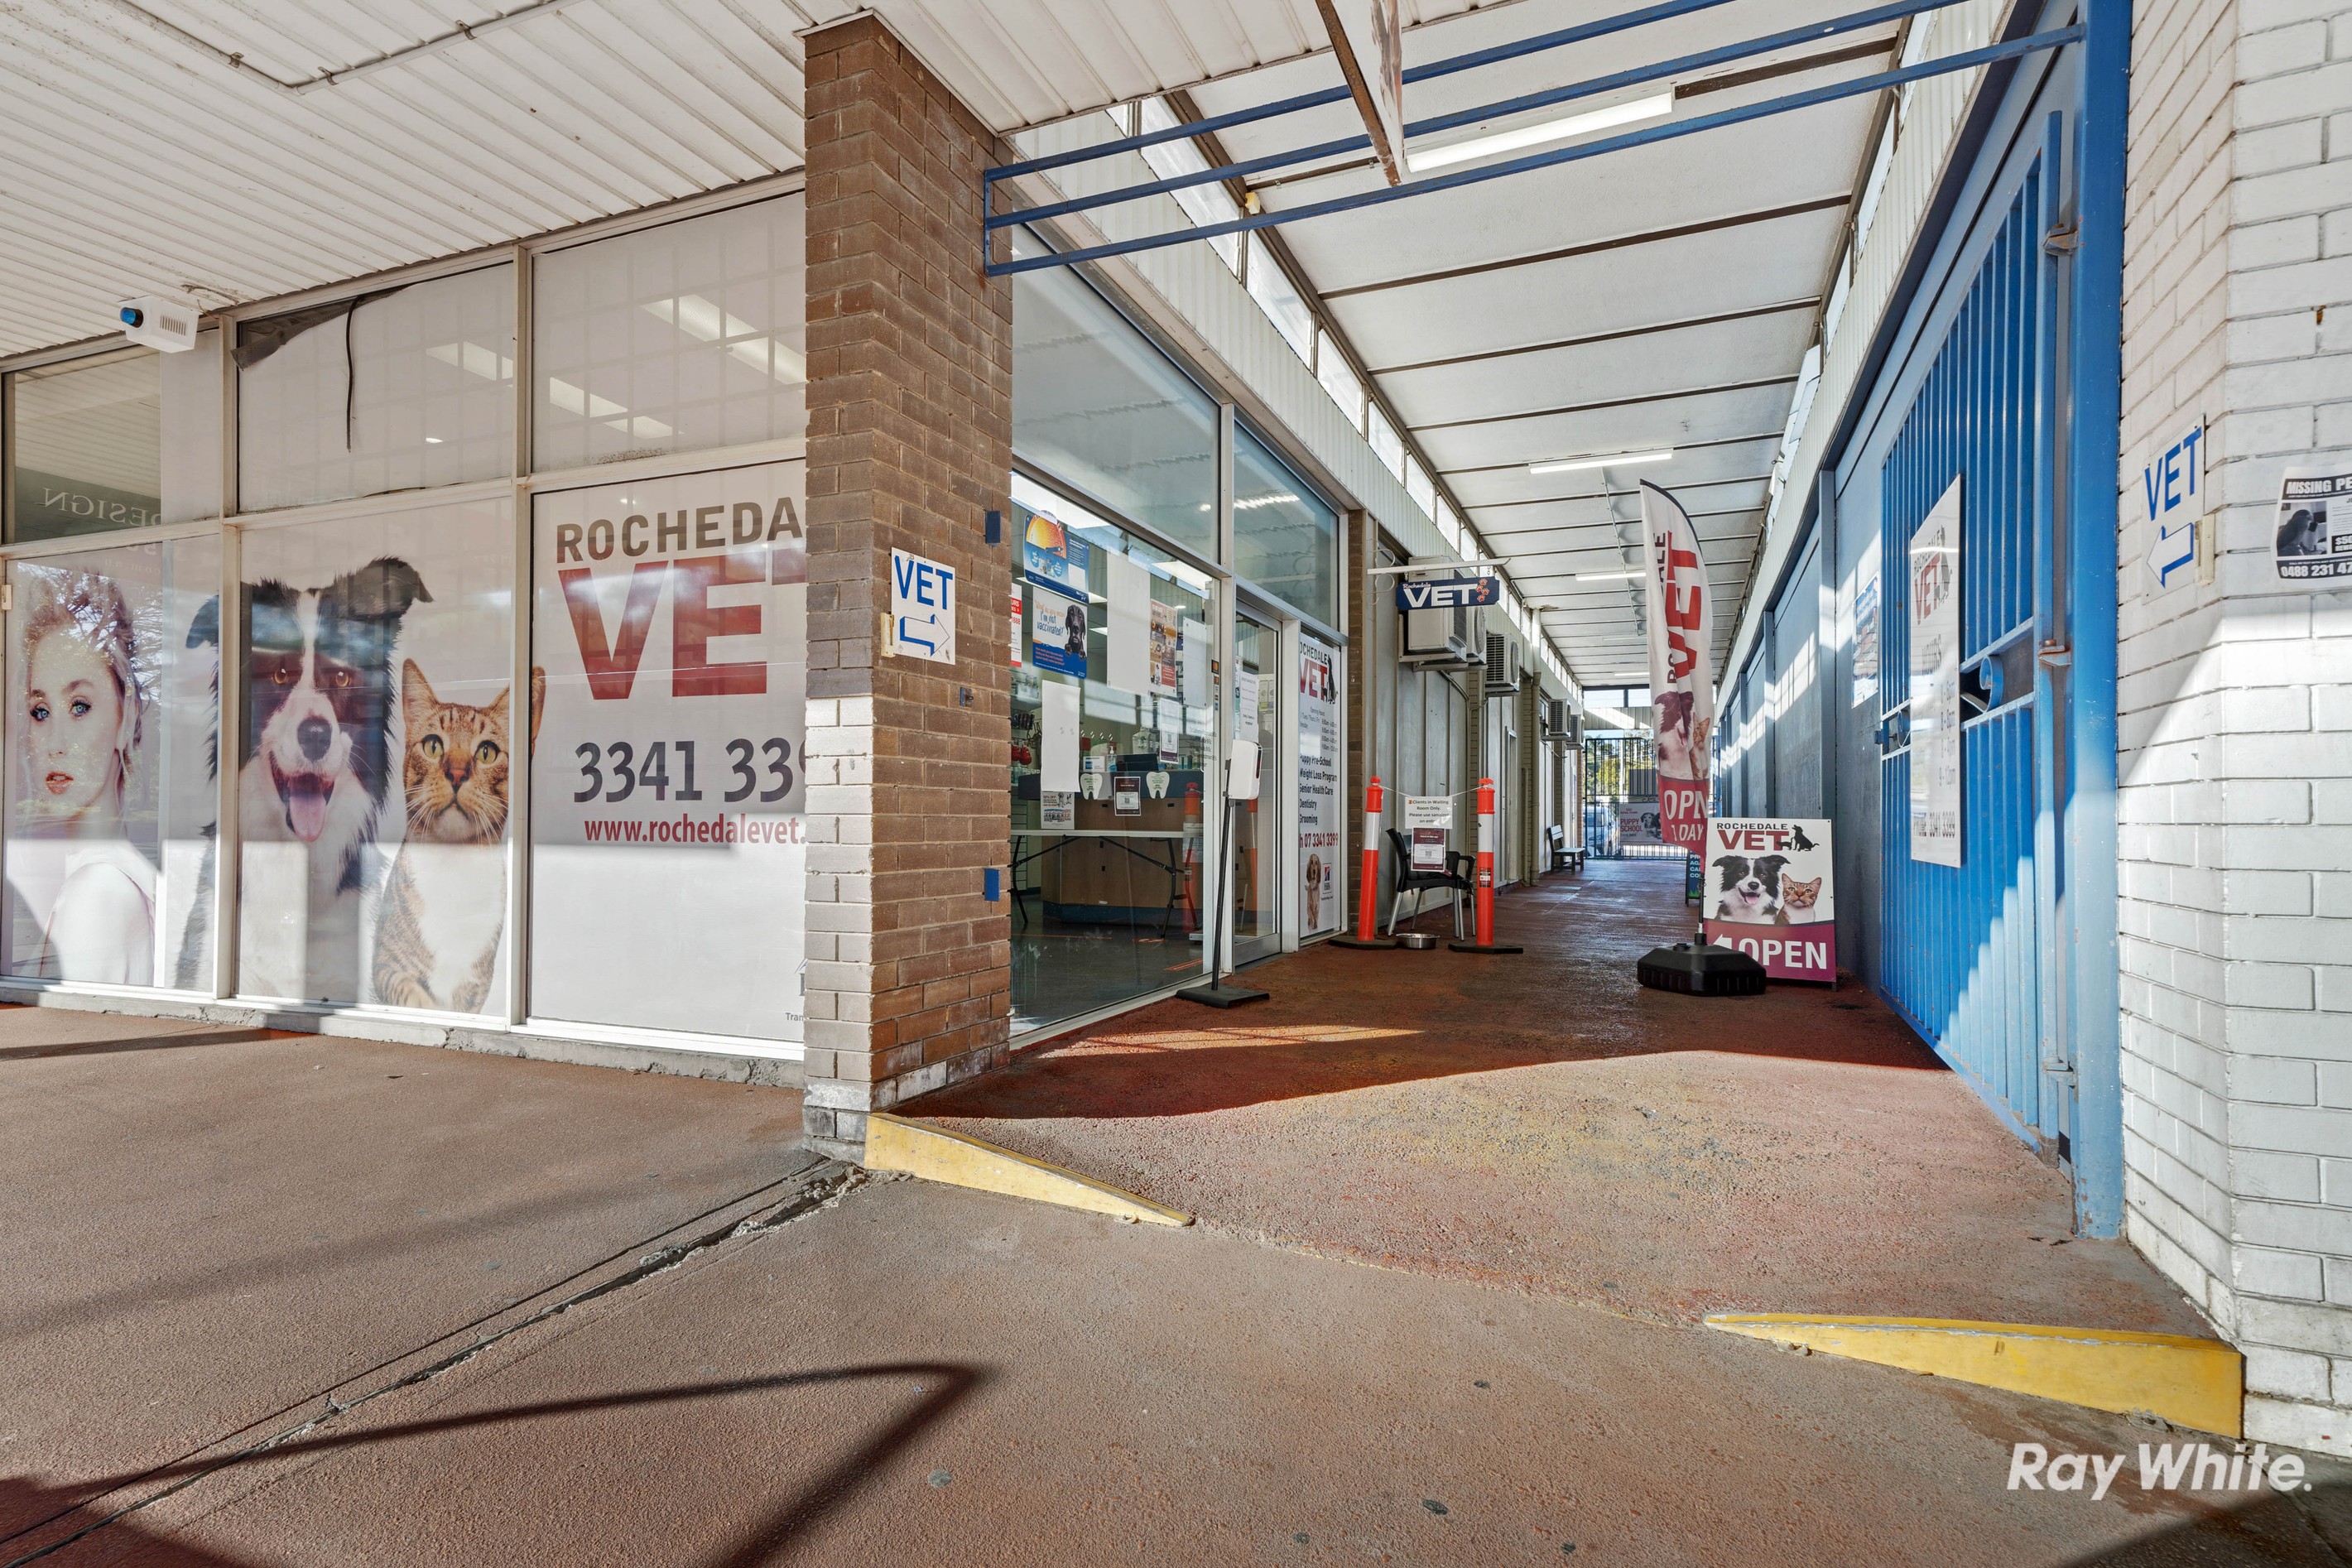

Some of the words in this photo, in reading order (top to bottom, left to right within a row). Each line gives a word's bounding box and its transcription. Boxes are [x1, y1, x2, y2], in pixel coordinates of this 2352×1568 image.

[2144, 426, 2202, 522] VET
[2286, 480, 2332, 495] MISSING
[556, 497, 803, 564] ROCHEDA
[894, 556, 953, 610] VET
[2280, 565, 2309, 578] 0488
[2311, 563, 2335, 577] 231
[1403, 584, 1478, 608] VET
[1914, 551, 1941, 626] VET
[1665, 530, 1702, 680] VET
[1300, 658, 1328, 701] VET
[574, 741, 702, 803] 3341
[724, 738, 806, 803] 33
[1313, 770, 1322, 780] Loss
[1322, 771, 1337, 782] Program
[1312, 784, 1325, 795] Health
[1325, 786, 1334, 795] Care
[584, 813, 806, 844] www.rochedalevet.
[1305, 833, 1311, 848] 07
[1312, 832, 1325, 848] 3341
[1325, 832, 1339, 847] 3399
[1718, 830, 1790, 851] VET
[1739, 938, 1827, 969] OPEN
